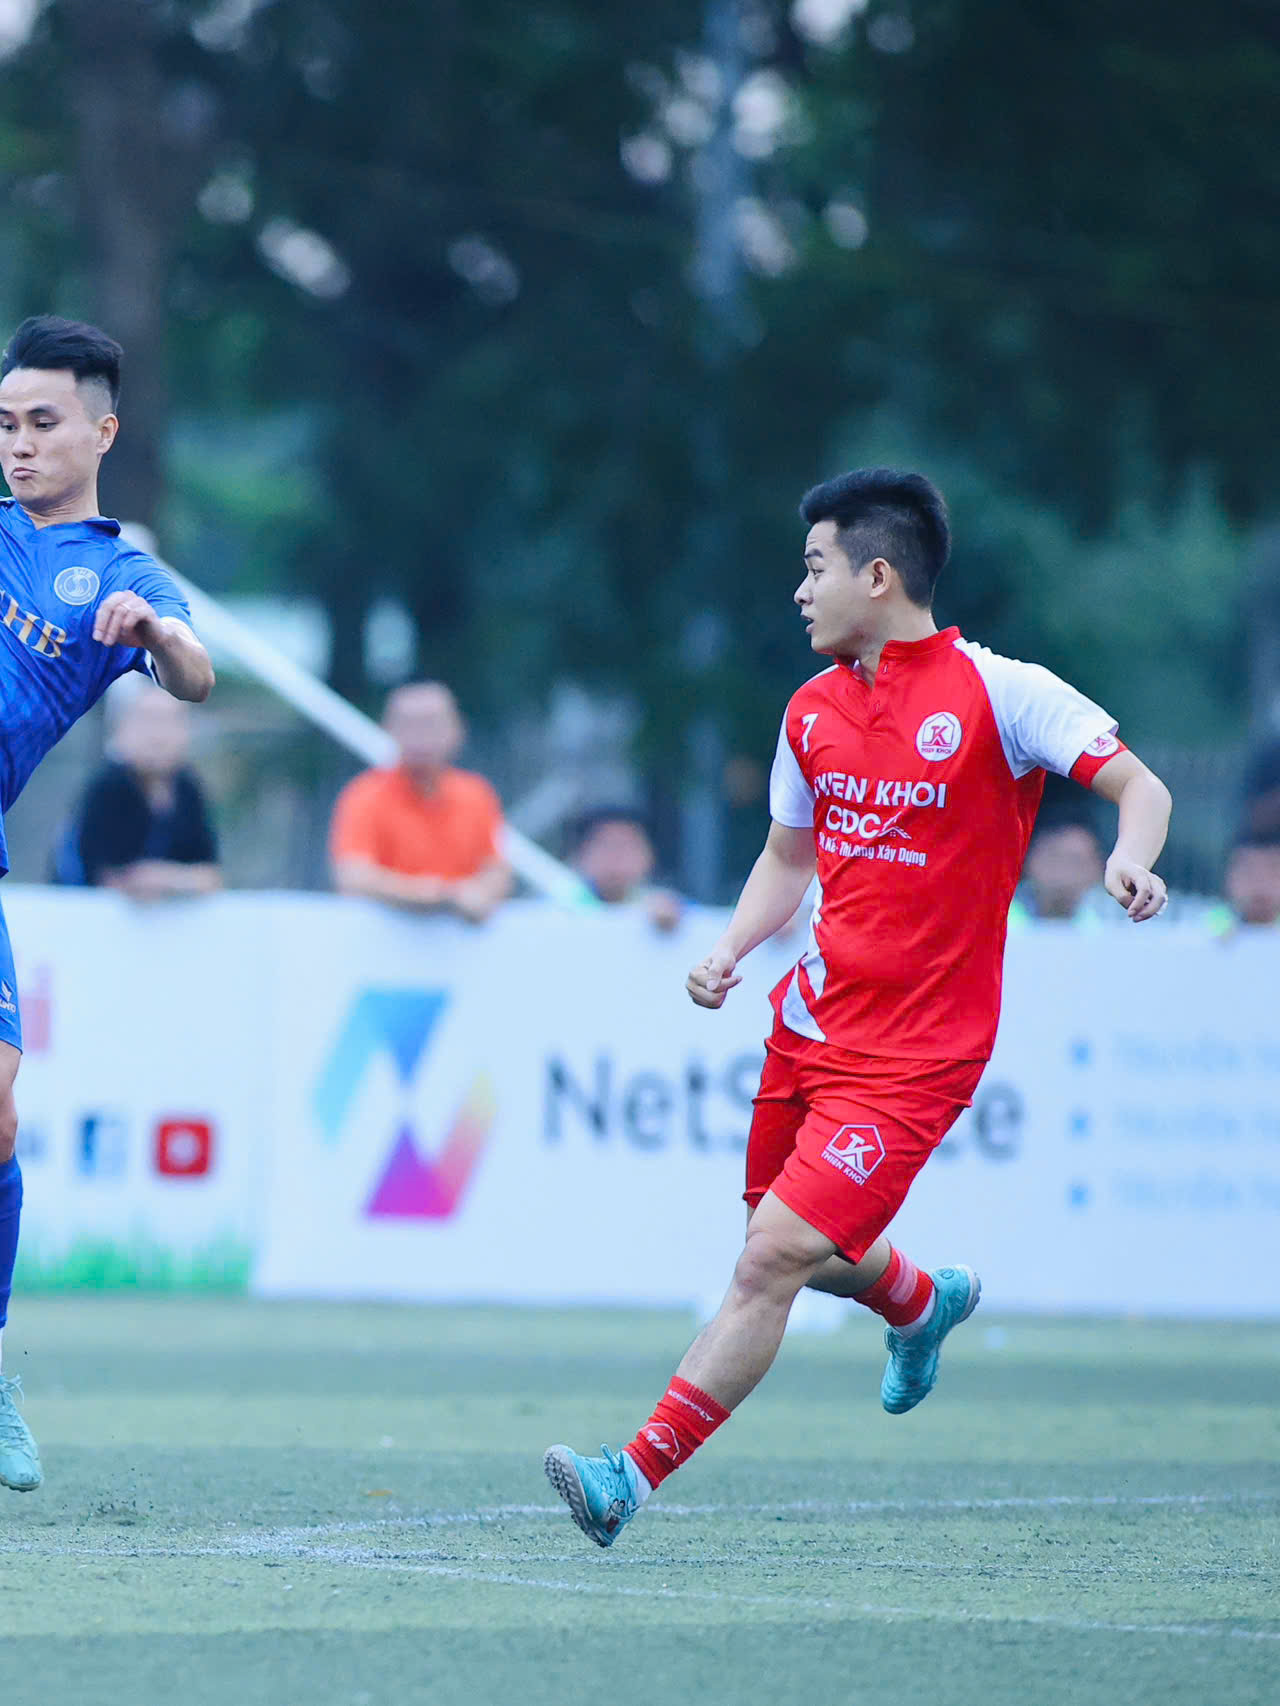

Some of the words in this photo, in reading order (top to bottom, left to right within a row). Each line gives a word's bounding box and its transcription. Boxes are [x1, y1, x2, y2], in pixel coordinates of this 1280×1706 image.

[801, 713, 819, 753] 7
[874, 780, 947, 808] KHOI
[825, 805, 882, 839] CDC
